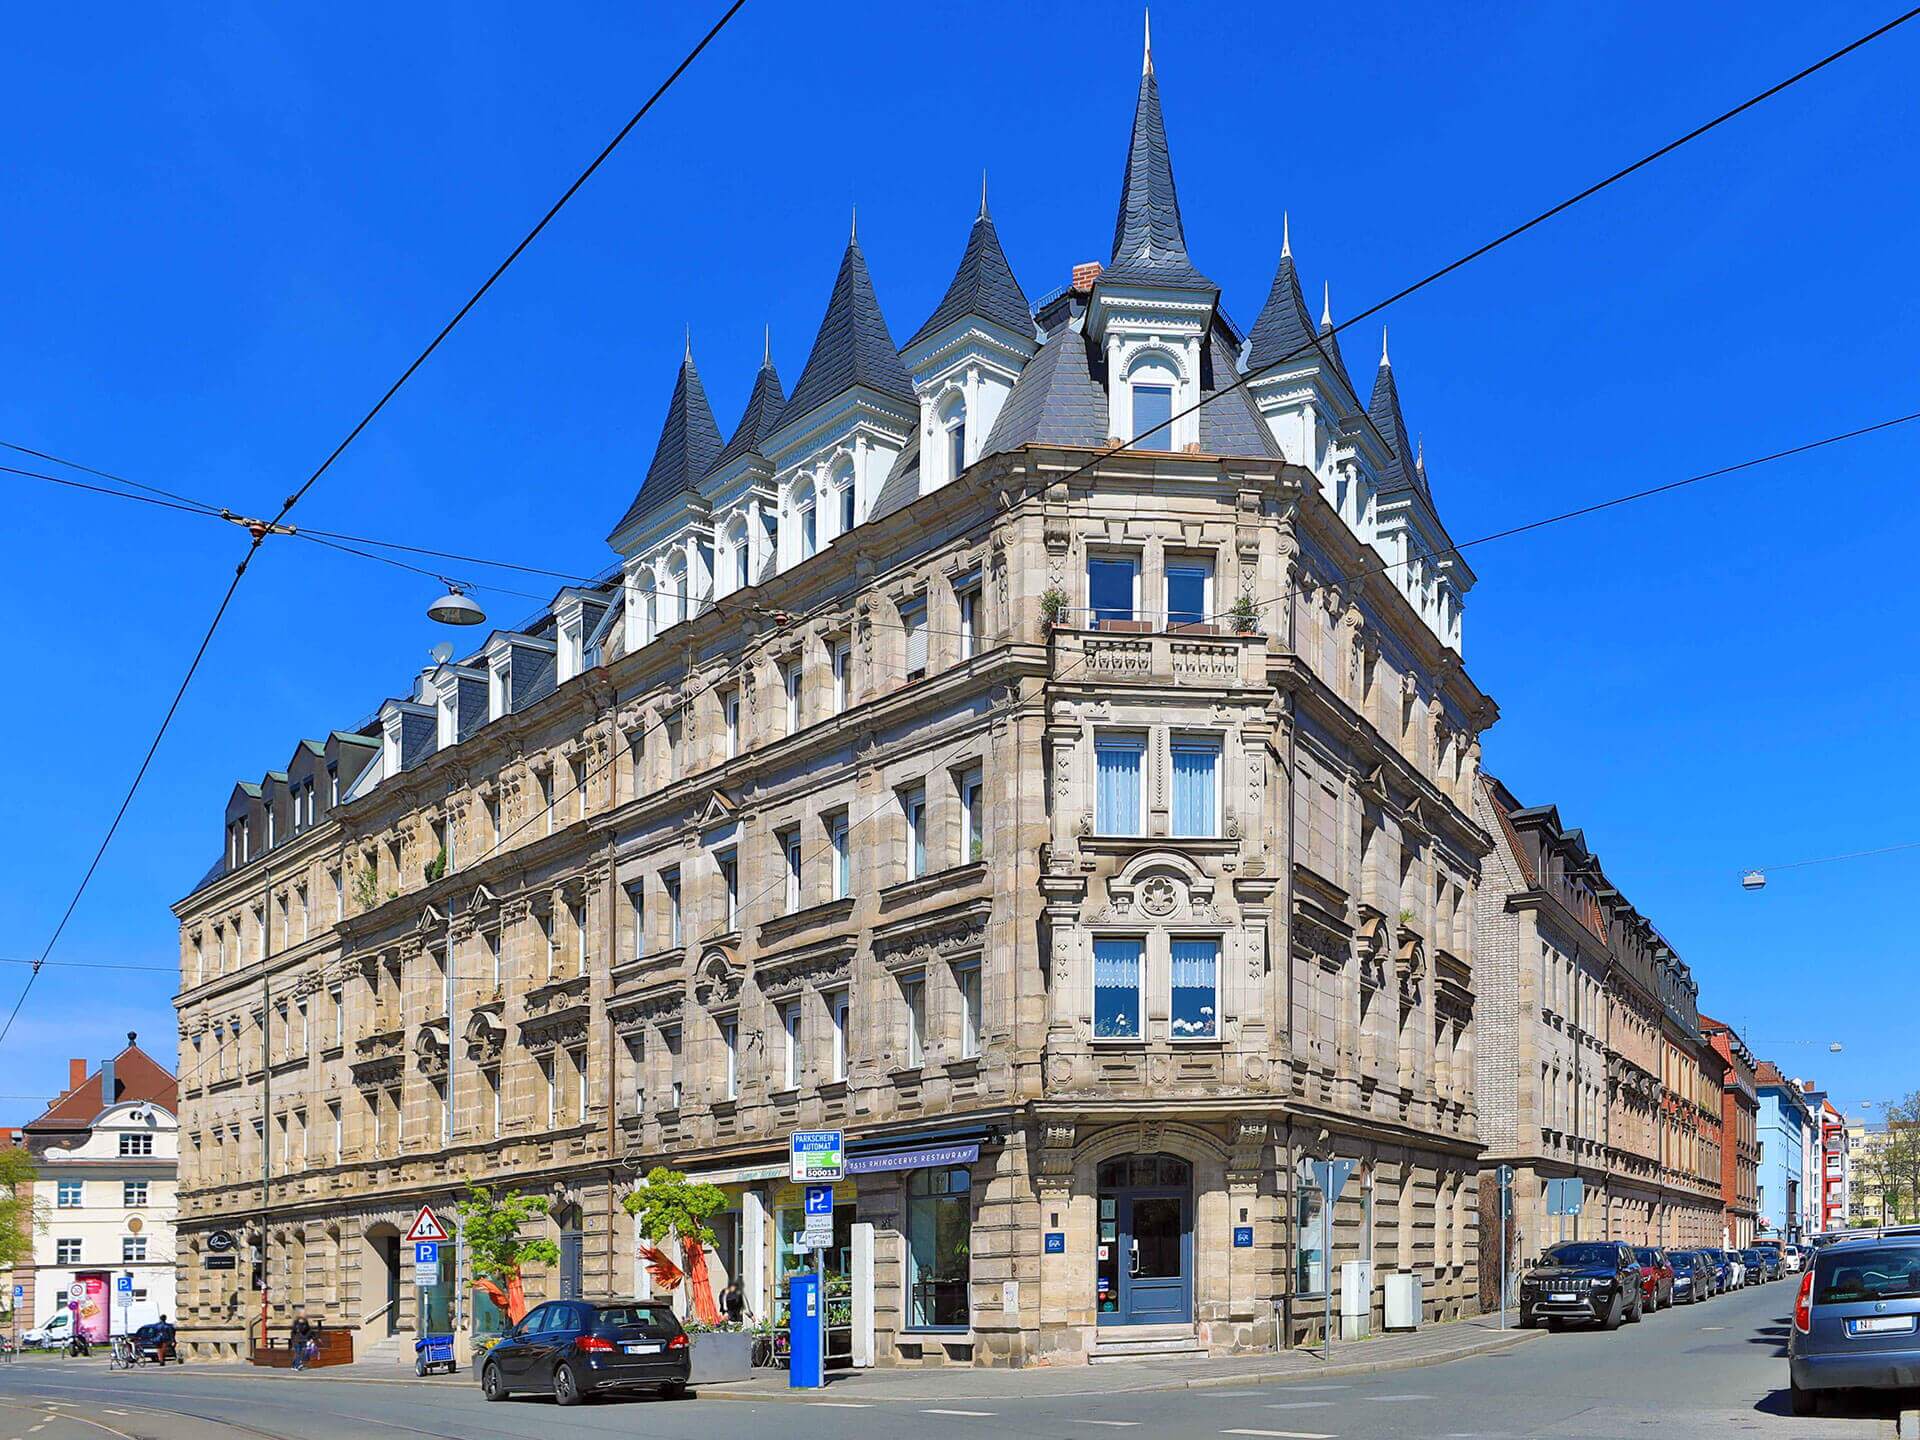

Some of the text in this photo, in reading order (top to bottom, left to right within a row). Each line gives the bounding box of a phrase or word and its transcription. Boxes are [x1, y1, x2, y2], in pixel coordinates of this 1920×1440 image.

[795, 1134, 838, 1143] PARKSCHEIN-
[803, 1142, 831, 1150] AUTOMAT
[921, 1149, 973, 1162] RESTAURANT
[810, 1190, 824, 1211] P
[420, 1245, 432, 1261] P
[119, 1279, 128, 1289] P
